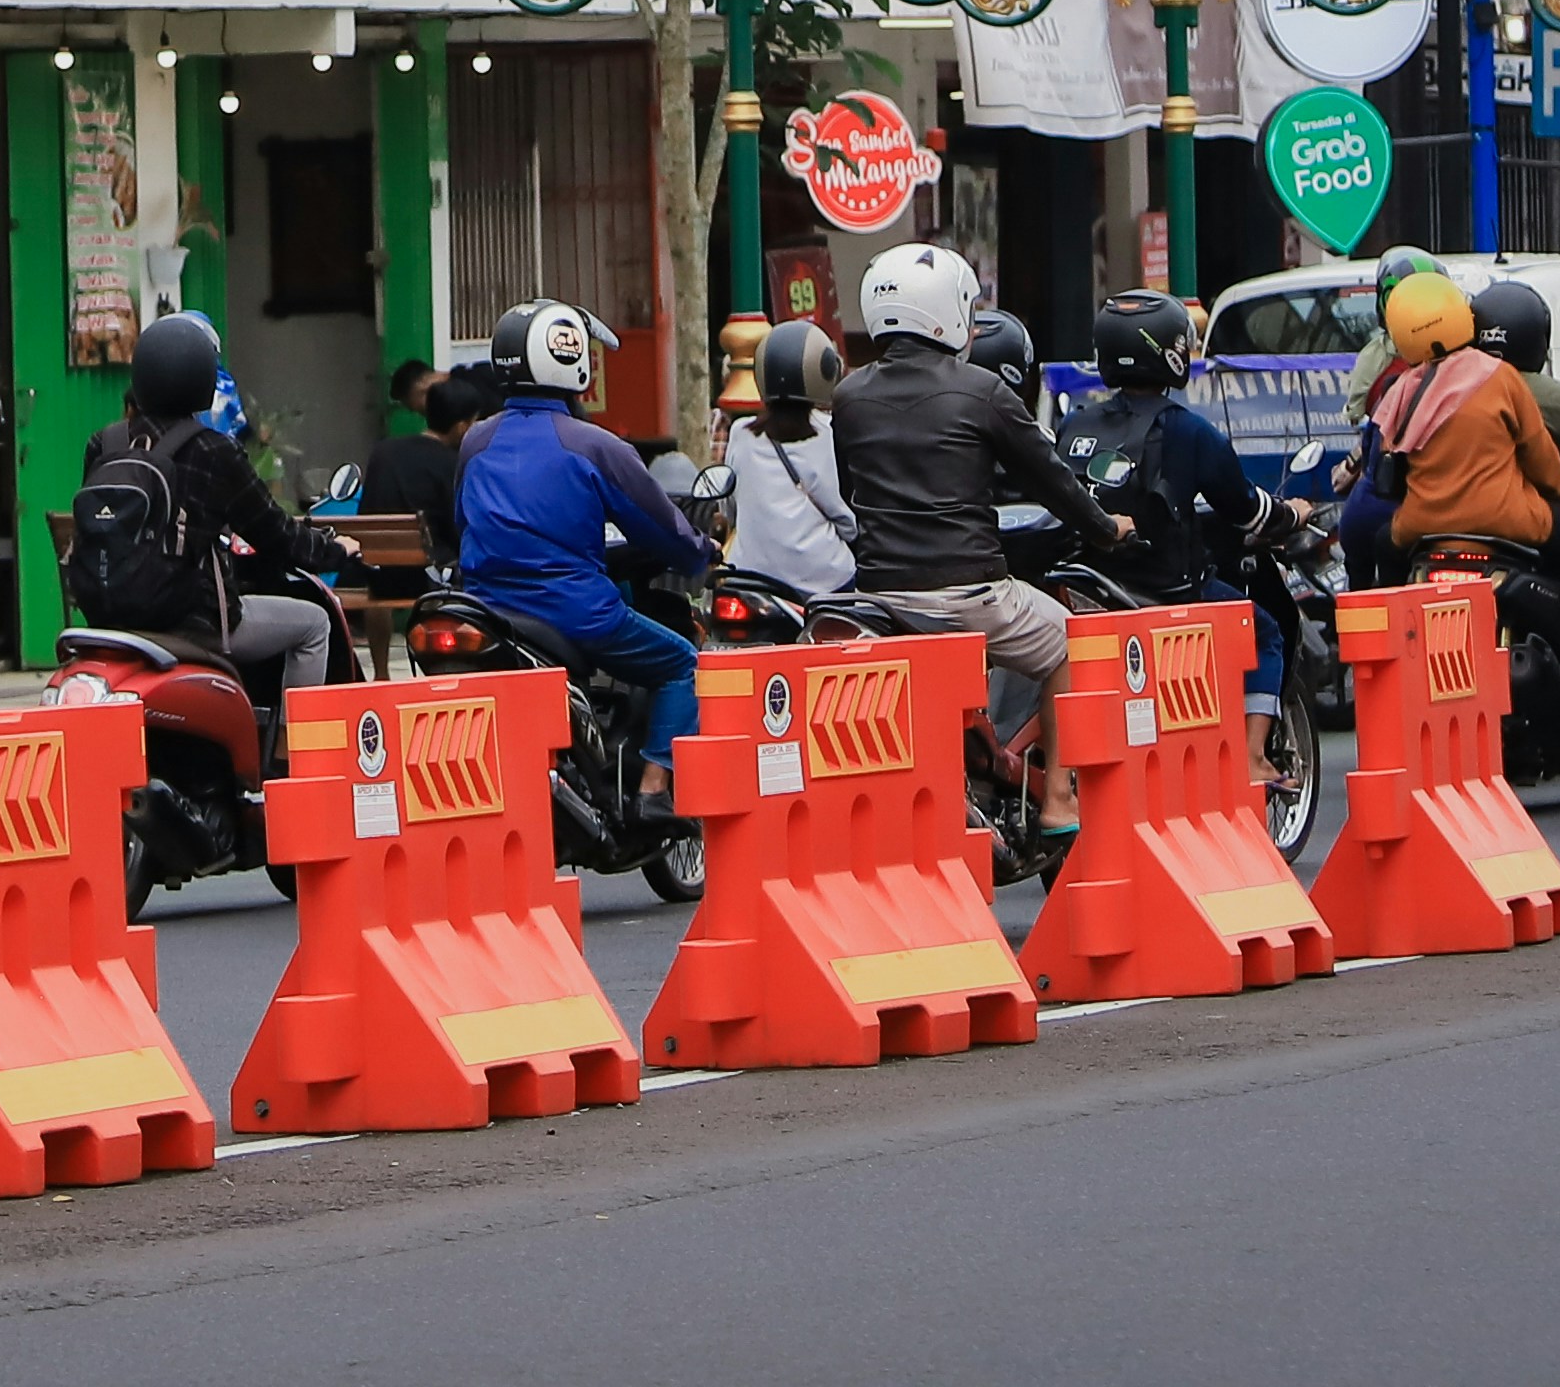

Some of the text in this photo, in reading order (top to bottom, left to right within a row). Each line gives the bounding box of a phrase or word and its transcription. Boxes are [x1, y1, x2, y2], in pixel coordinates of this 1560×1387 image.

[1292, 111, 1357, 133] Tersedia di
[1291, 129, 1367, 166] Grab
[1293, 157, 1373, 198] Food
[789, 277, 817, 314] 99
